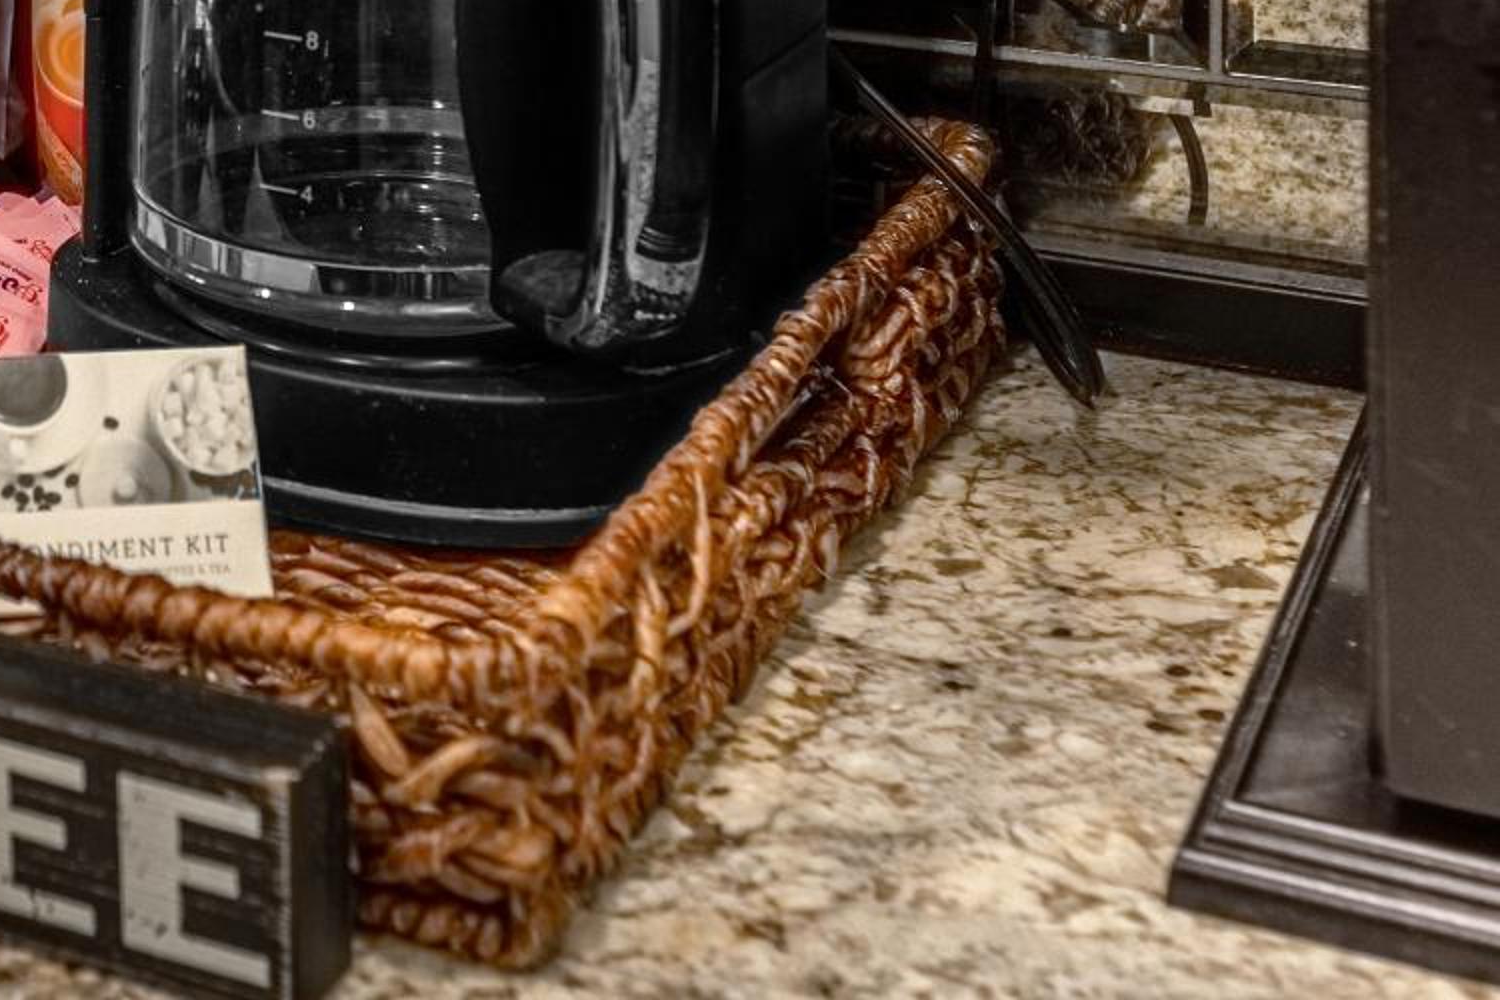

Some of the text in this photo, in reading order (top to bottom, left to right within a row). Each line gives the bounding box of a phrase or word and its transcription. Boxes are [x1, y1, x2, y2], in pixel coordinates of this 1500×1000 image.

[305, 31, 319, 51] 8
[302, 111, 316, 130] 6
[299, 184, 314, 204] 4
[184, 533, 229, 556] KIT
